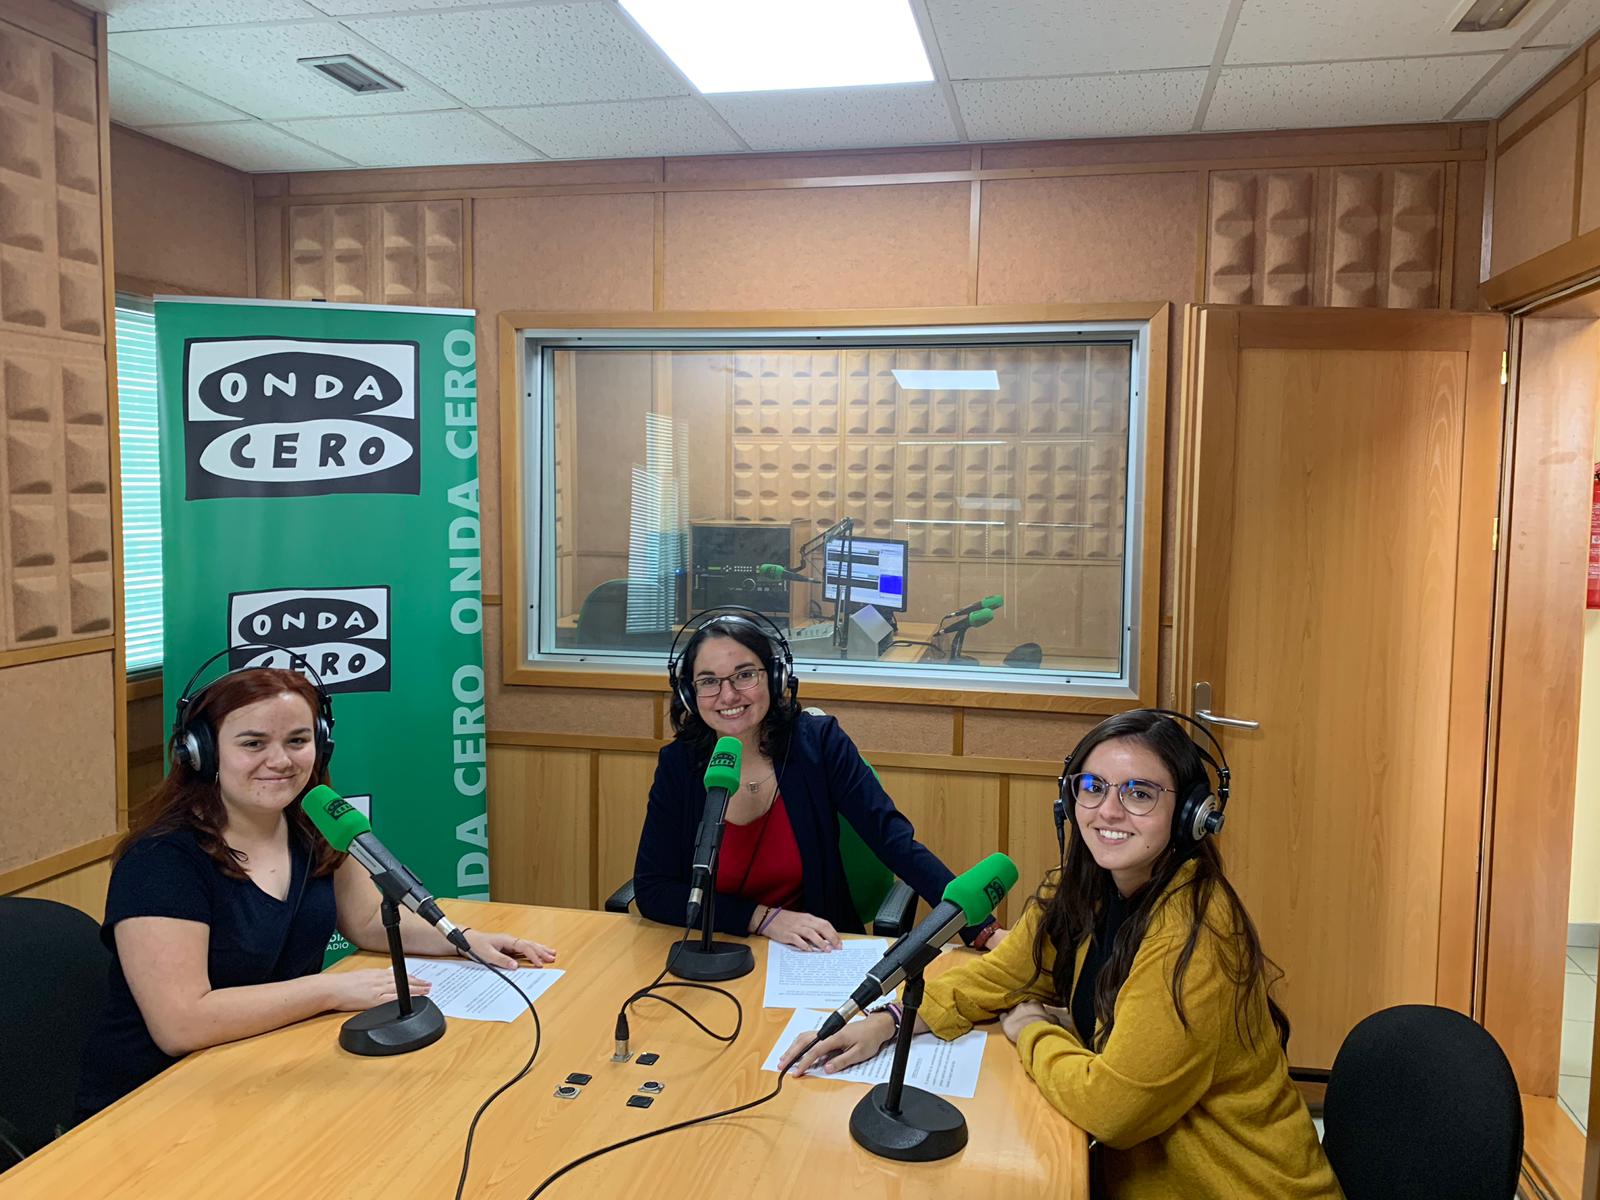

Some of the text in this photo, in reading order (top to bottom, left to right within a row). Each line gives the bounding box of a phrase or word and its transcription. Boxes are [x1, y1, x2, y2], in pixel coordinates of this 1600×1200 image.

[220, 372, 383, 402] ONDA
[230, 432, 385, 469] CERO
[252, 610, 365, 636] ONDA
[443, 328, 490, 902] DA CERO ONDA CERO
[326, 941, 349, 951] ADIO
